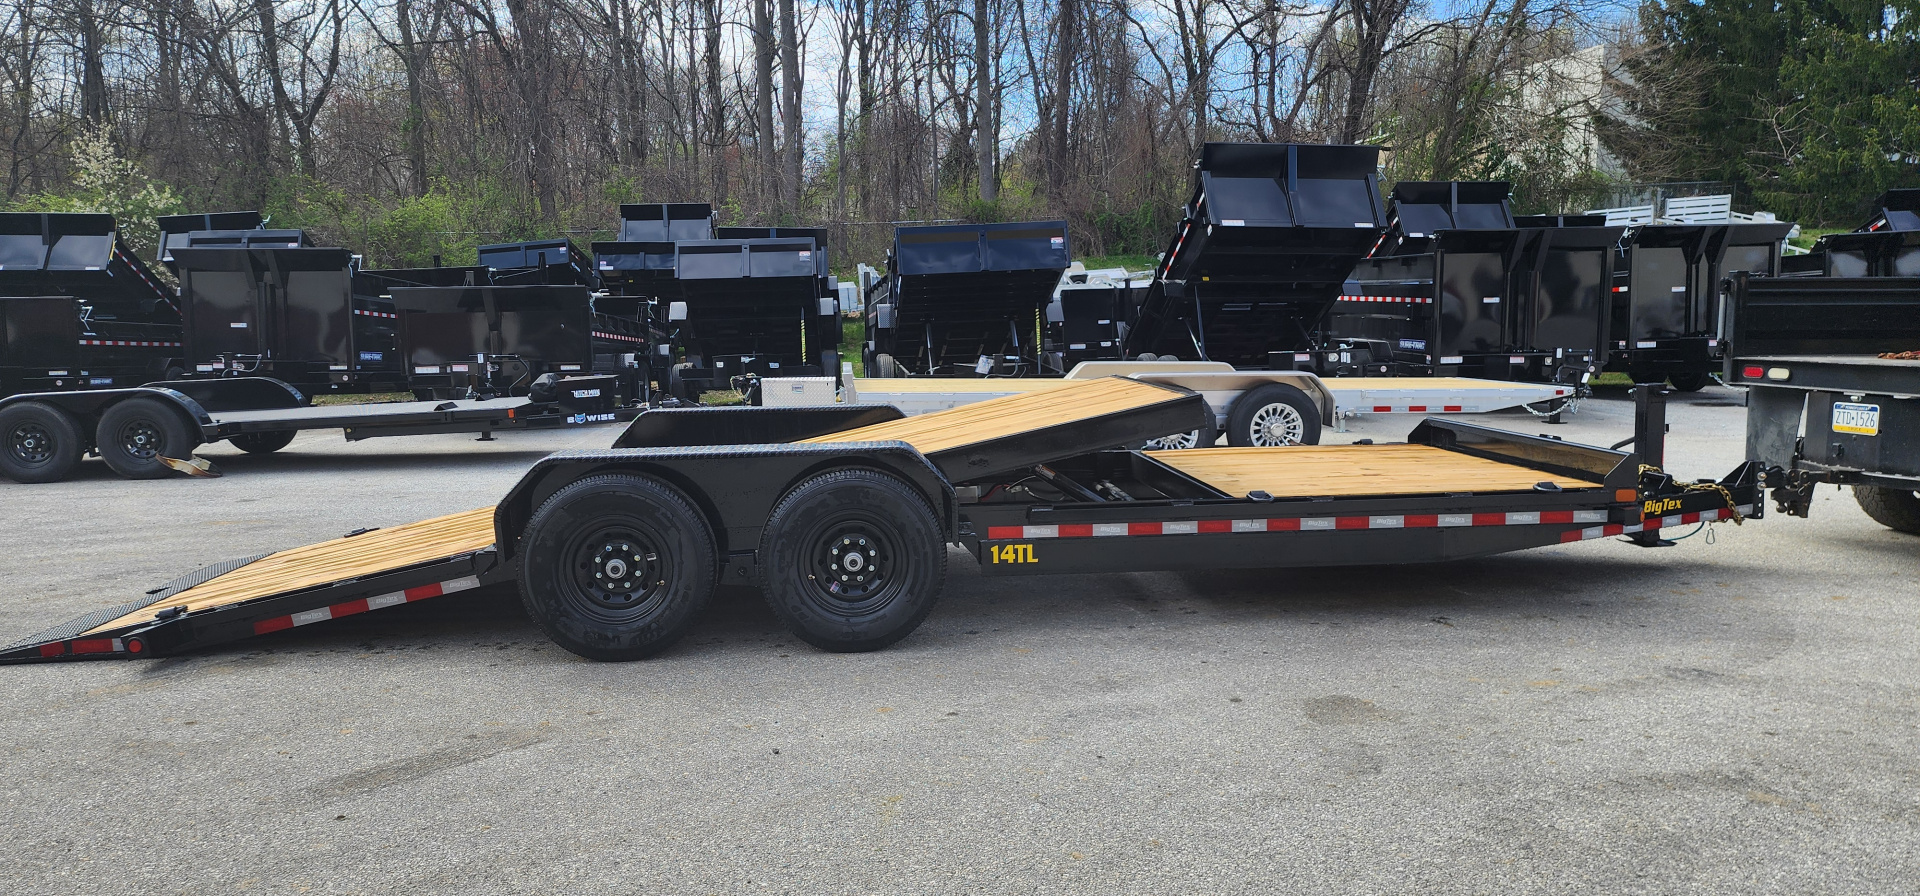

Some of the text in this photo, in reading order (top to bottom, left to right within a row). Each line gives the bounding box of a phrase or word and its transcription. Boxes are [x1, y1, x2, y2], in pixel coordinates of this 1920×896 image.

[1644, 498, 1683, 515] BigTex
[990, 544, 1038, 564] 14TL
[300, 611, 323, 620] BigTex
[375, 595, 398, 604] BigTex
